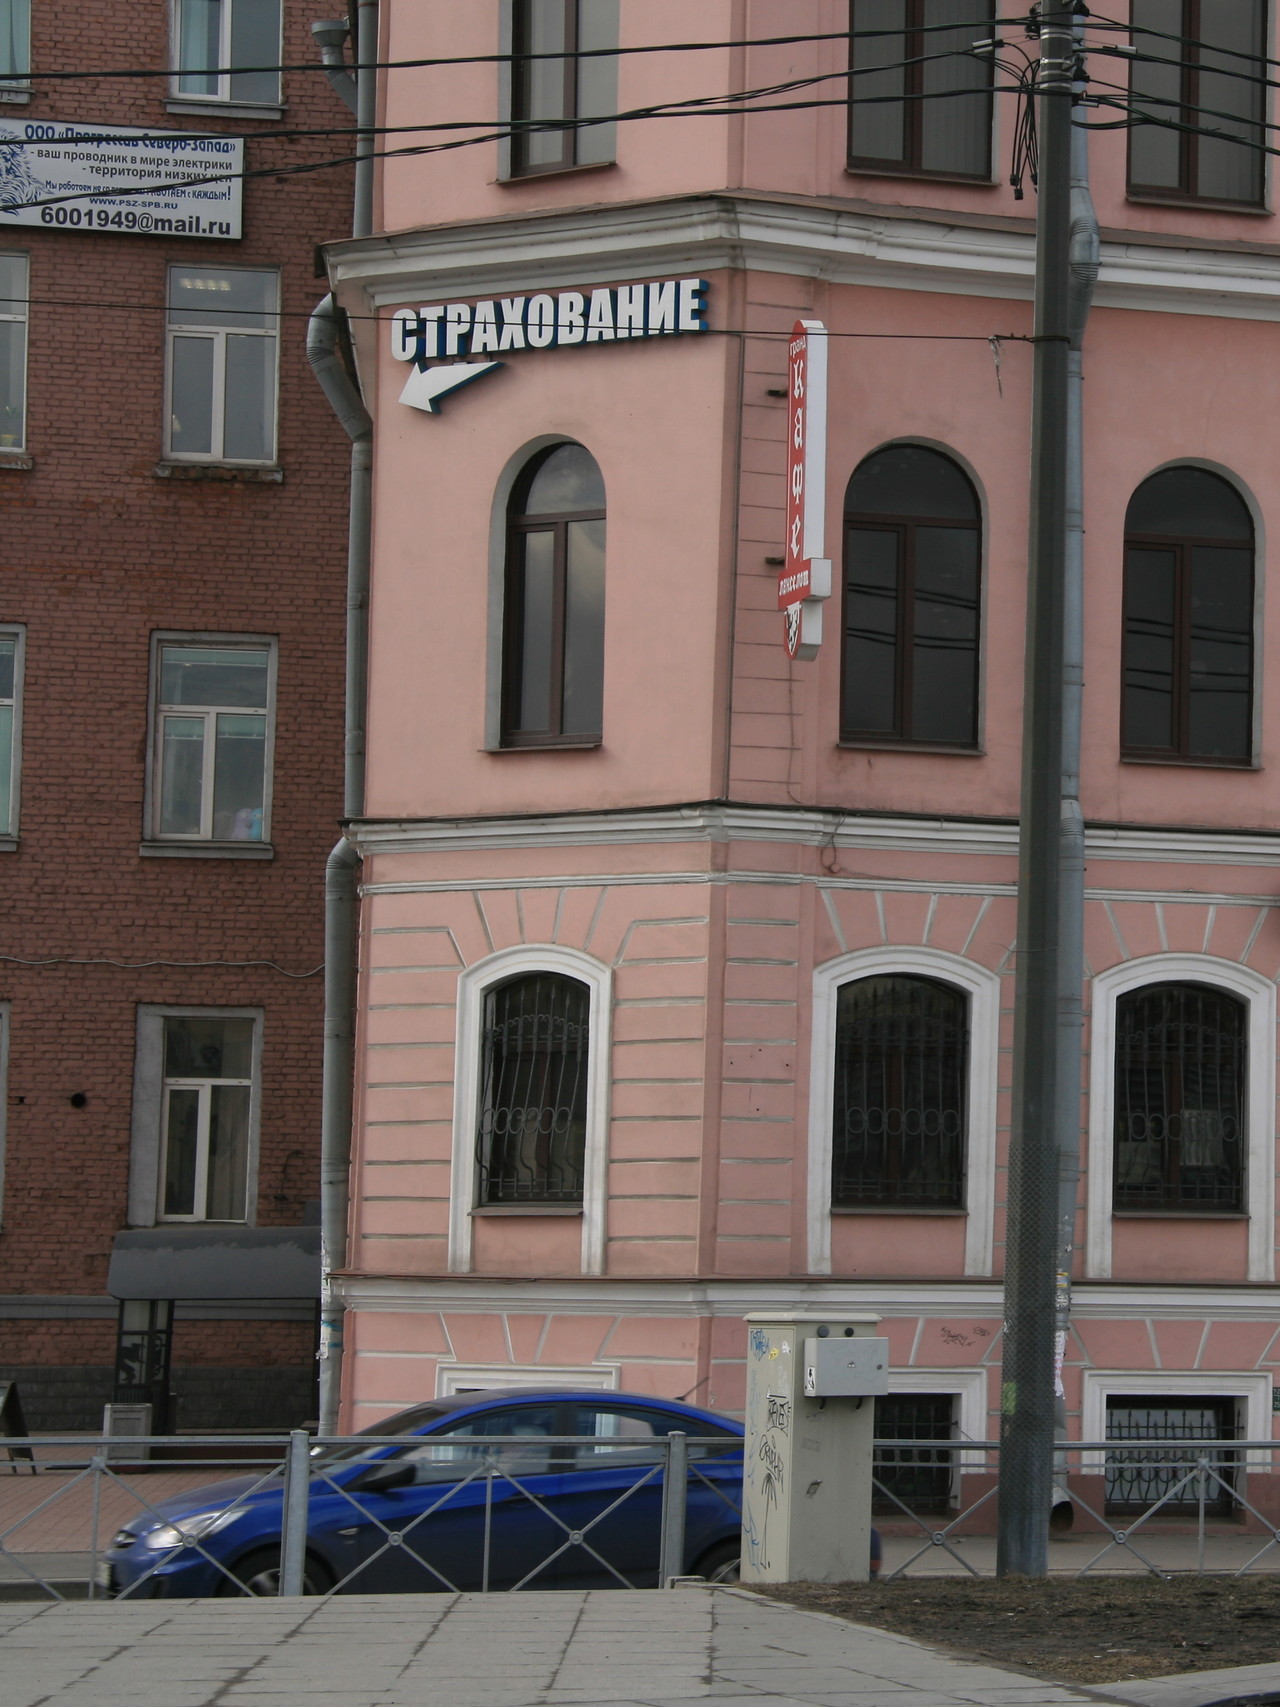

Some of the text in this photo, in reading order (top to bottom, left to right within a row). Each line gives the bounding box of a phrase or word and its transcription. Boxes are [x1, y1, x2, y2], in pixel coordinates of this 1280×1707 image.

[24, 124, 55, 140] ООО
[37, 149, 61, 159] ваш
[63, 151, 128, 164] проводник
[130, 156, 138, 165] в
[140, 156, 170, 168] мире
[172, 159, 232, 172] электрики
[89, 165, 162, 180] территория
[165, 170, 208, 181] низких
[45, 180, 57, 189] Мы
[58, 180, 92, 192] работаем
[40, 206, 231, 236] 6001949@mail.ru
[390, 278, 707, 363] СТРАХОВАНИЕ
